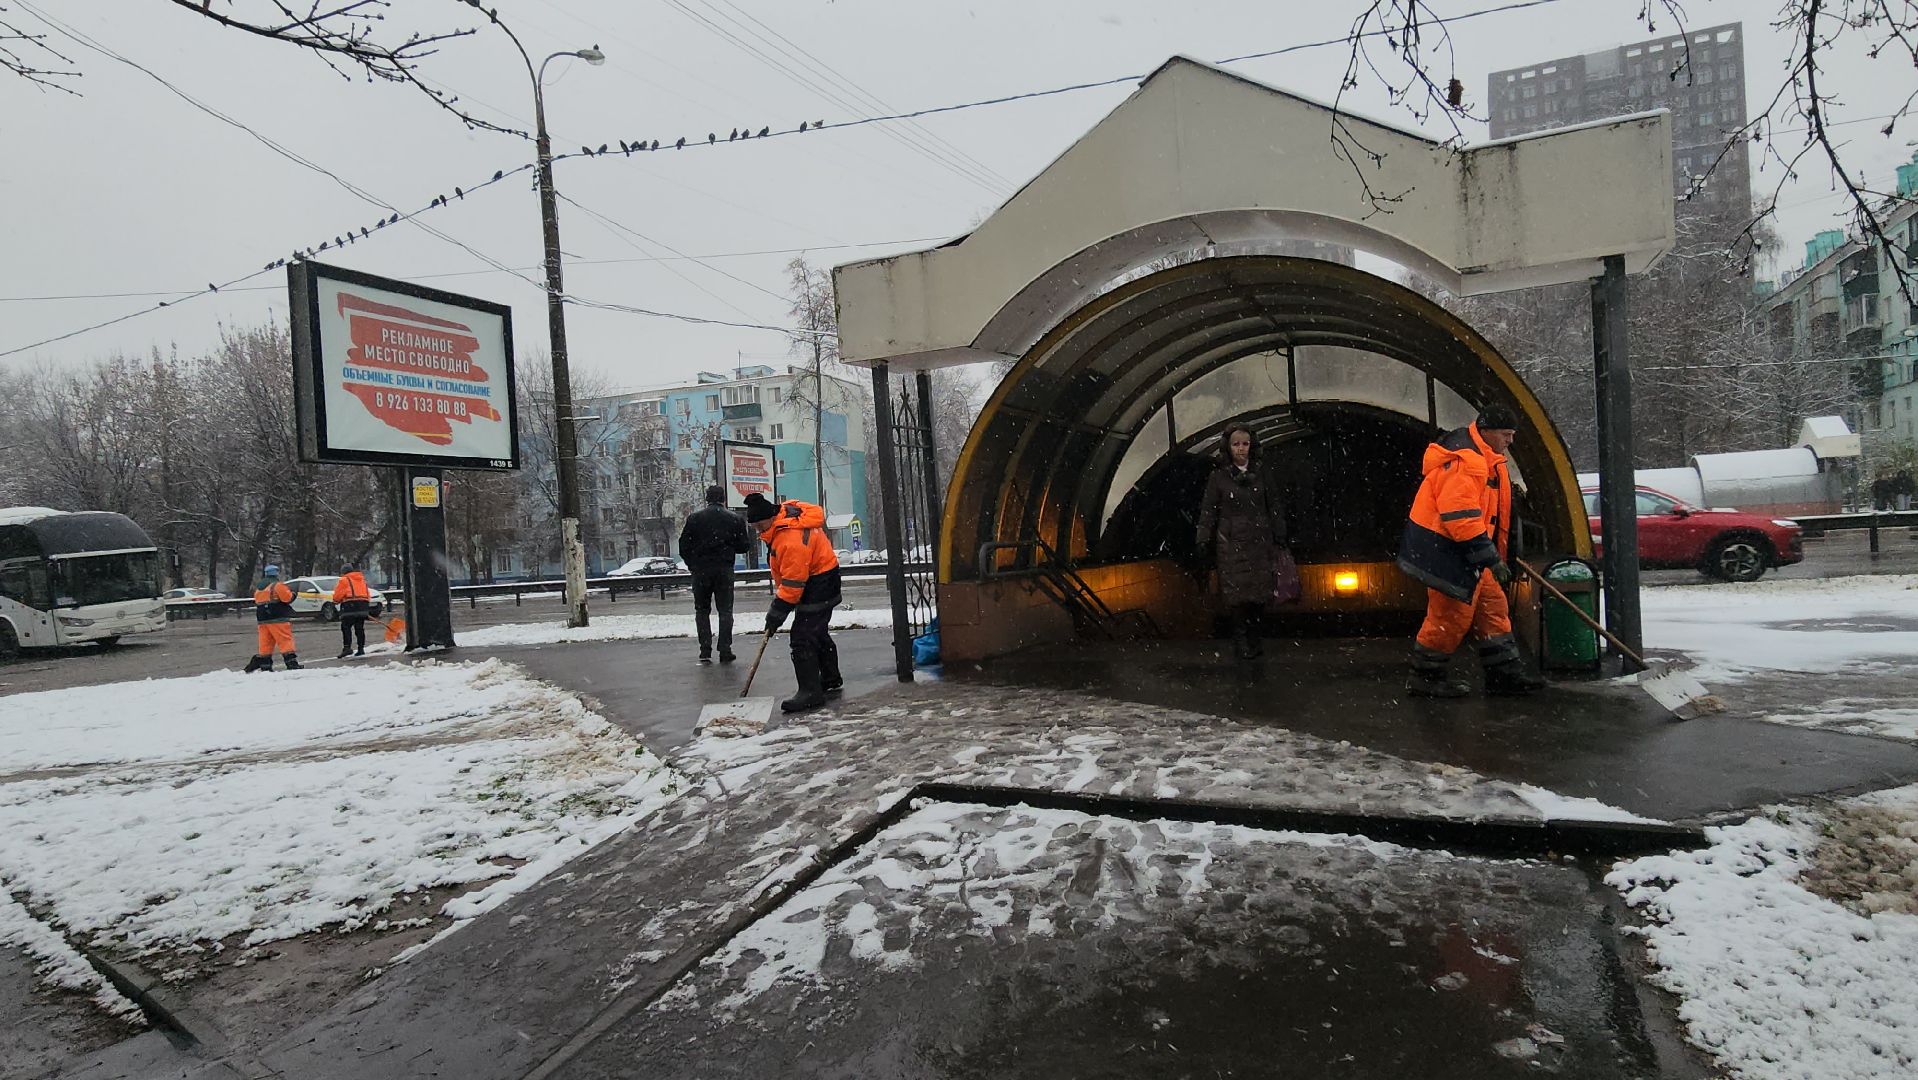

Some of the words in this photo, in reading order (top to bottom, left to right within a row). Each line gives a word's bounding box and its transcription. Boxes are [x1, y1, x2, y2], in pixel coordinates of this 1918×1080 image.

[382, 328, 454, 353] РЕКЛАМНОЕ
[364, 344, 406, 364] МЕСТО
[409, 352, 470, 374] СВОБОДНО
[343, 367, 393, 385] ОБЪЕМНЫЕ
[397, 374, 425, 389] БУКВЫ
[427, 379, 433, 389] И
[436, 380, 491, 397] СОГЛАСОВАНИЕ
[376, 392, 383, 407] 8
[387, 394, 409, 410] 926
[413, 397, 433, 412] 133
[437, 399, 450, 415] 80
[454, 401, 467, 416] 88
[489, 460, 506, 468] 1439
